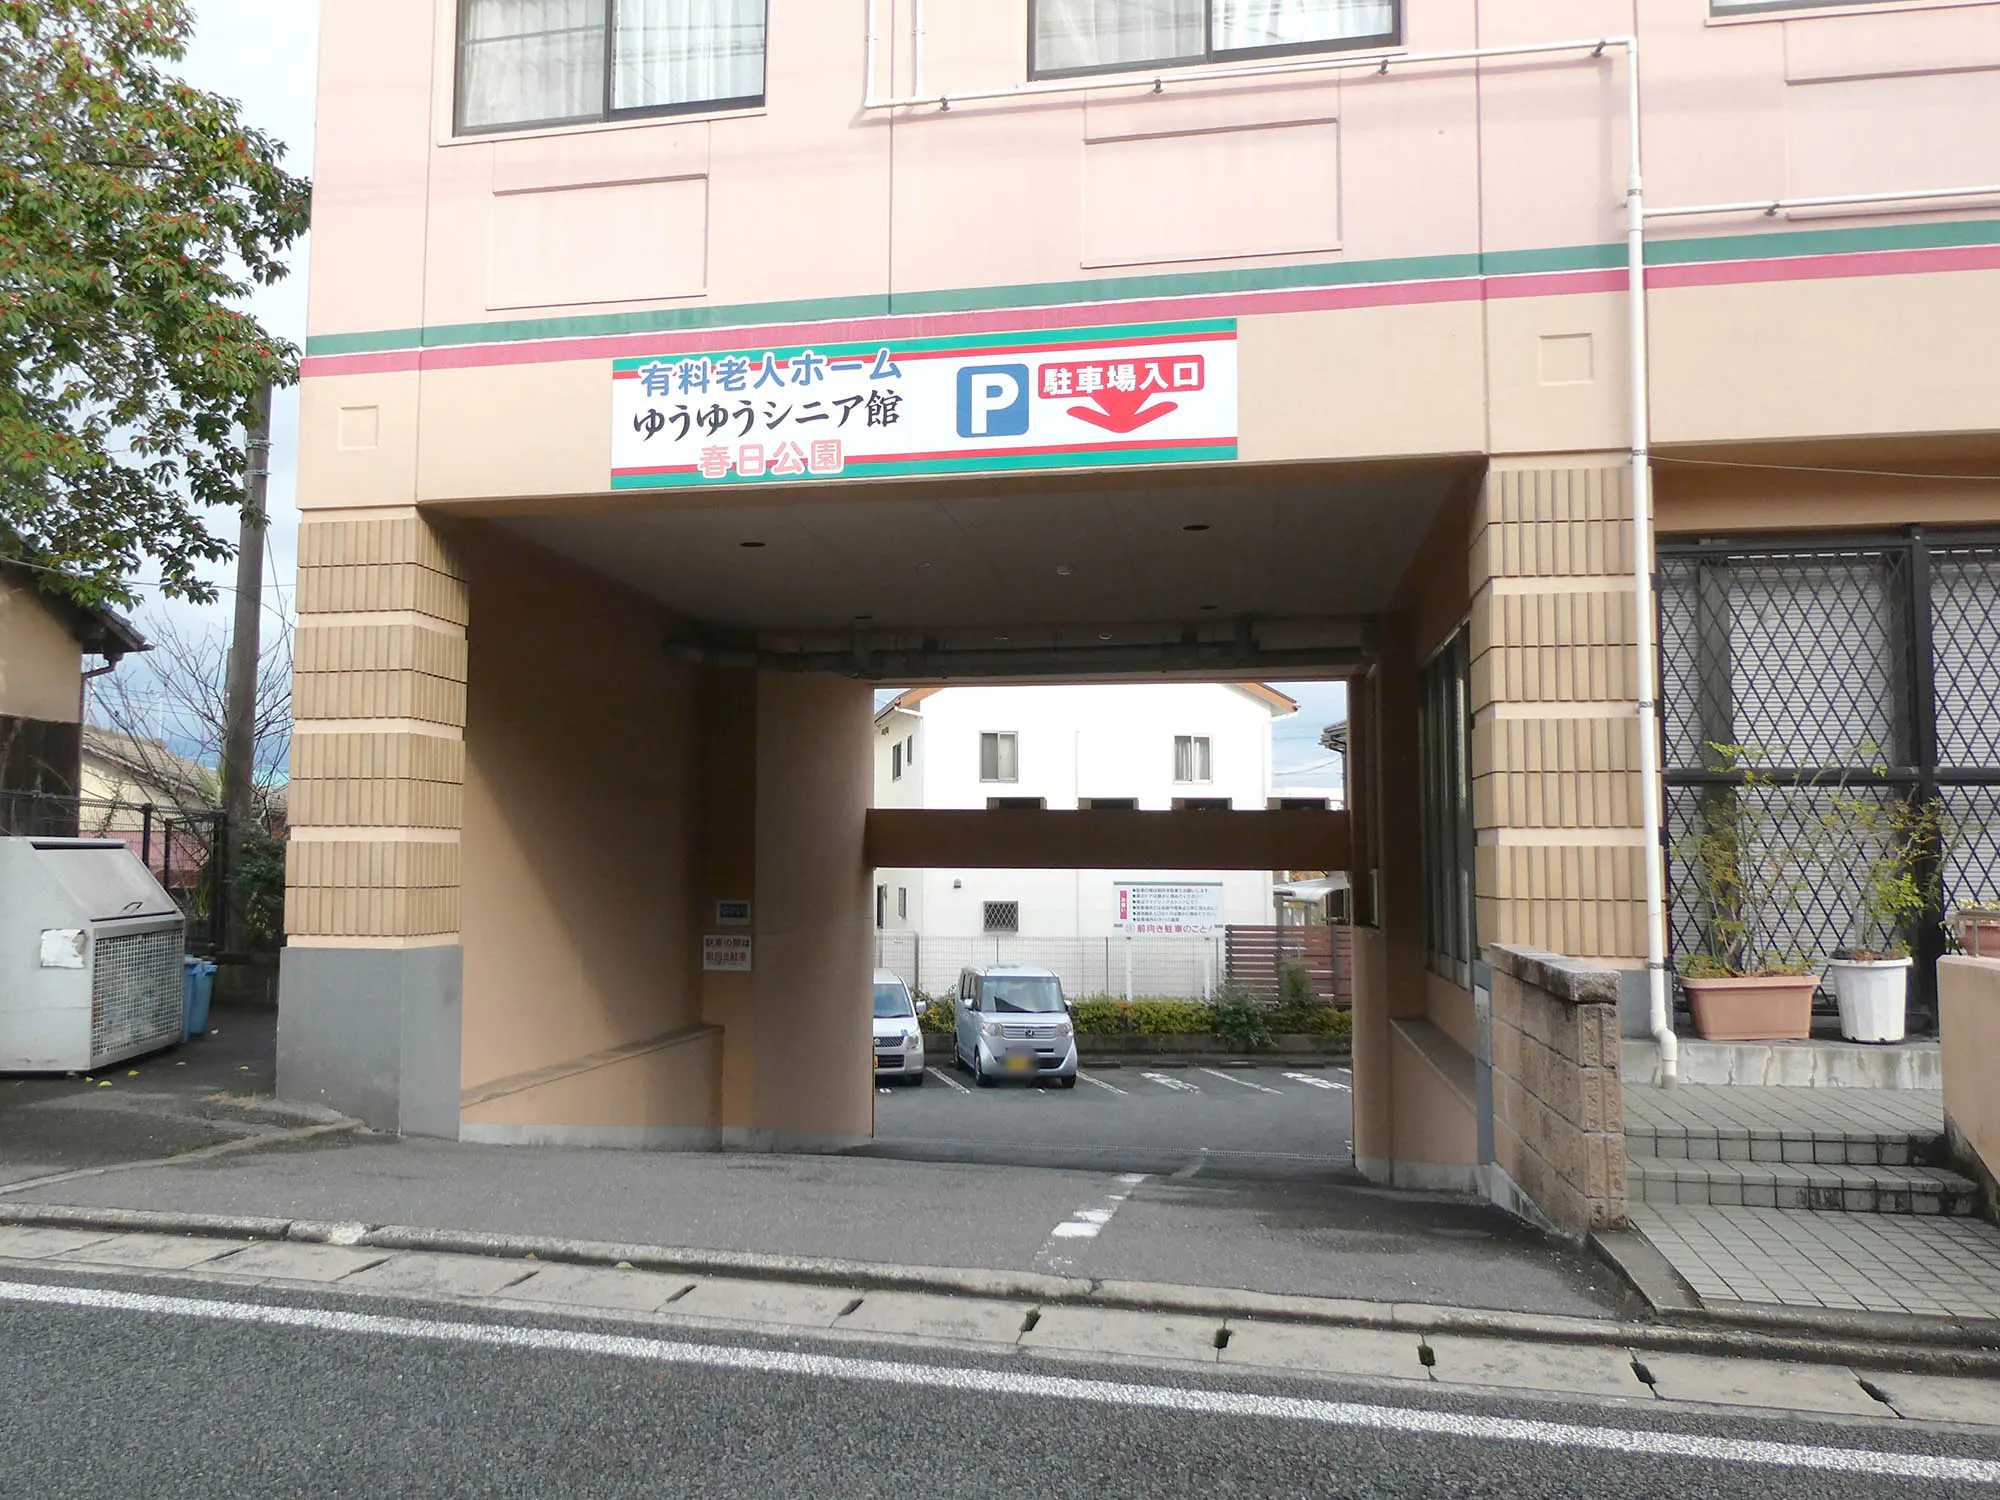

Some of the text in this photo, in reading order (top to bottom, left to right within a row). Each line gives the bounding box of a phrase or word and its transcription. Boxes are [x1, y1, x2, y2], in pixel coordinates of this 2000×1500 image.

[640, 349, 902, 398] 有料老人ホーム
[1042, 361, 1200, 396] 駐車場入口
[633, 388, 904, 442] ゆうゆうシニア館
[970, 372, 1020, 434] P
[699, 439, 842, 477] 春日公園
